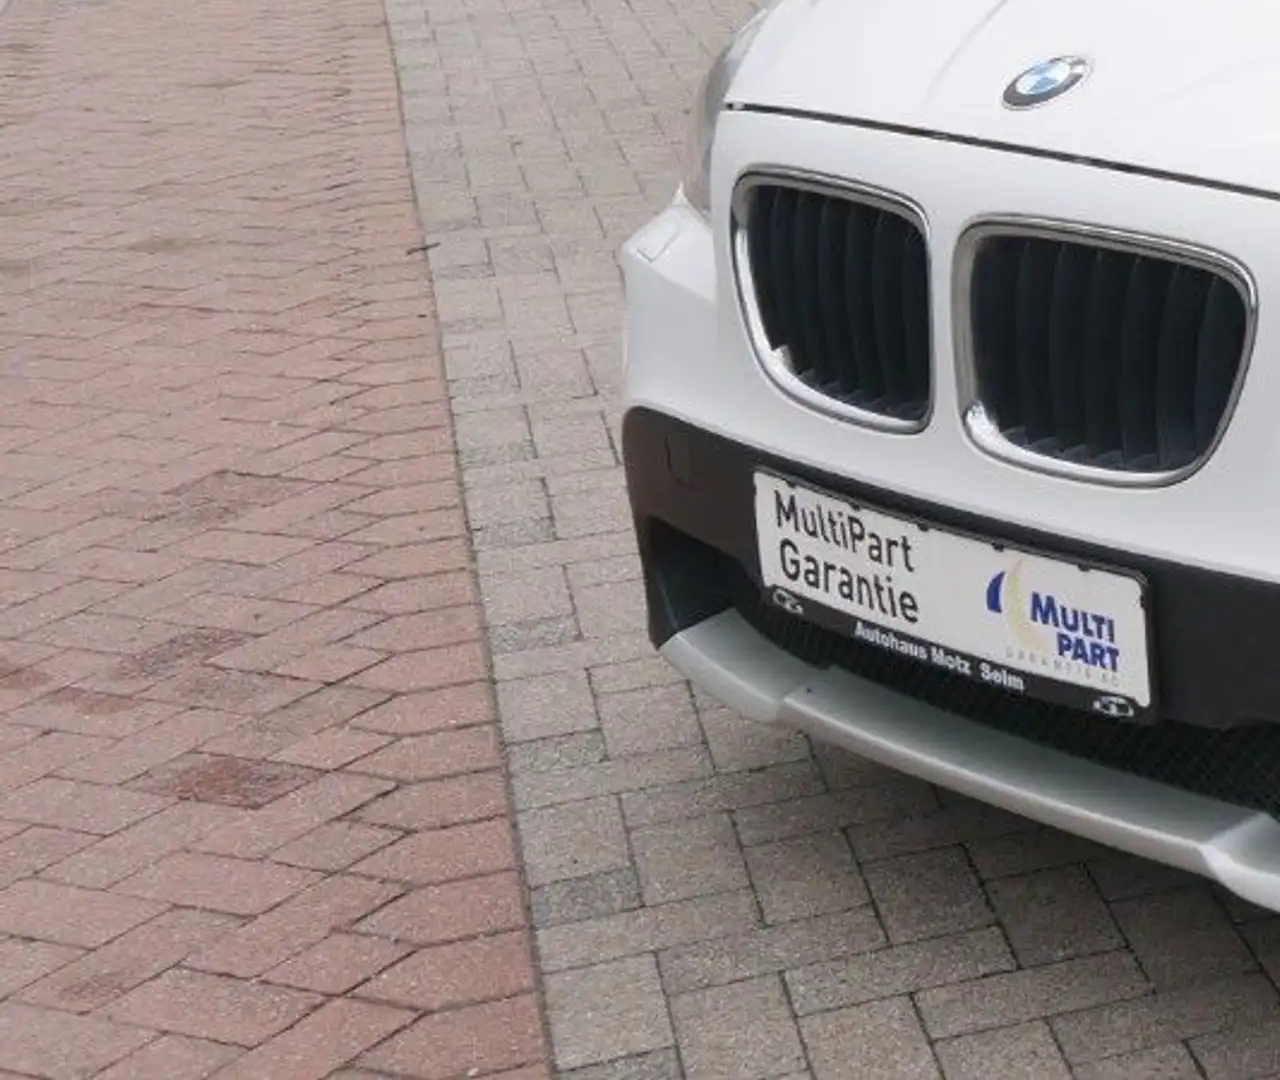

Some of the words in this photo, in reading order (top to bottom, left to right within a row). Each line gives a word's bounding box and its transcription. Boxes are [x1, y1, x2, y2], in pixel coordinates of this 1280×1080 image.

[773, 489, 915, 573] MultiPart
[779, 537, 919, 624] Garantie
[854, 621, 928, 660] Autohaus
[1030, 590, 1116, 644] MULTI
[1056, 631, 1120, 673] PART
